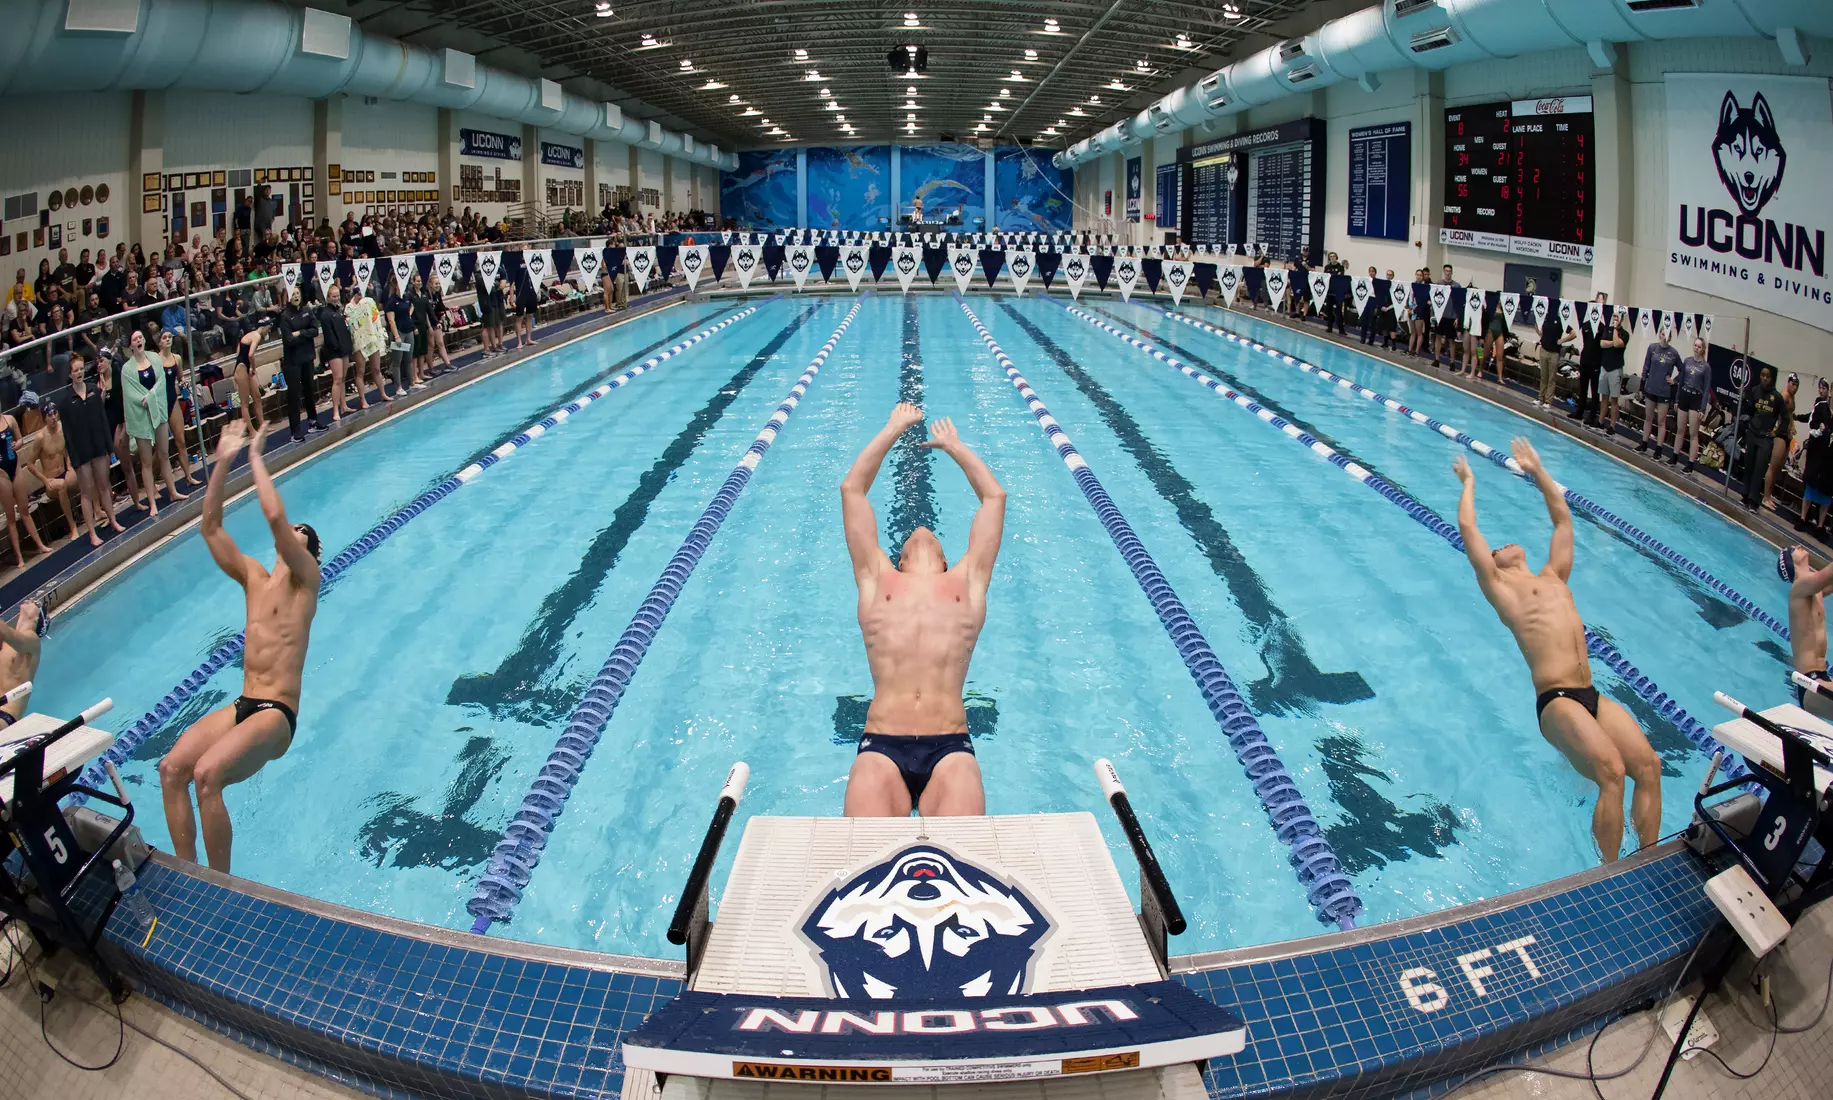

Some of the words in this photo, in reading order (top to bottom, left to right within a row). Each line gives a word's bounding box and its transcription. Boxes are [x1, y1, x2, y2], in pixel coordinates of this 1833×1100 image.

[1448, 114, 1462, 122] EVENT
[1495, 110, 1508, 118] HEAT
[1503, 119, 1510, 133] 2
[1512, 125, 1526, 133] LANE
[1526, 124, 1544, 133] PLACE
[1556, 123, 1569, 132] TIME
[471, 132, 504, 150] UCONN
[1207, 140, 1230, 154] SWIMMING
[1234, 135, 1252, 147] DIVING
[1252, 130, 1279, 144] RECORDS
[1474, 136, 1484, 144] MEN
[1492, 142, 1507, 150] GUEST
[547, 145, 571, 160] UCONN
[1453, 144, 1466, 152] HOME
[1498, 152, 1510, 165] 21
[1517, 151, 1523, 166] 2
[1454, 175, 1467, 183] HOME
[1492, 175, 1508, 184] GUEST
[1517, 168, 1523, 182] 3
[1533, 168, 1540, 183] 2
[1457, 183, 1469, 197] 56
[1517, 186, 1523, 199] 4
[1444, 205, 1461, 214] LENGTHS
[1476, 207, 1496, 216] RECORD
[1516, 202, 1523, 217] 5
[1516, 220, 1522, 235] 6
[1449, 230, 1474, 242] UCONN
[1679, 203, 1825, 278] UCONN
[1549, 242, 1580, 257] UCONN
[1671, 252, 1749, 281] SWIMMING
[1757, 272, 1765, 285] &
[1774, 277, 1832, 304] DIVING
[1764, 815, 1787, 850] 3
[43, 825, 68, 864] 5
[1399, 966, 1448, 1014] 6
[1456, 934, 1542, 997] FT
[738, 1000, 1140, 1035] UCONN
[754, 1065, 891, 1081] WARNING
